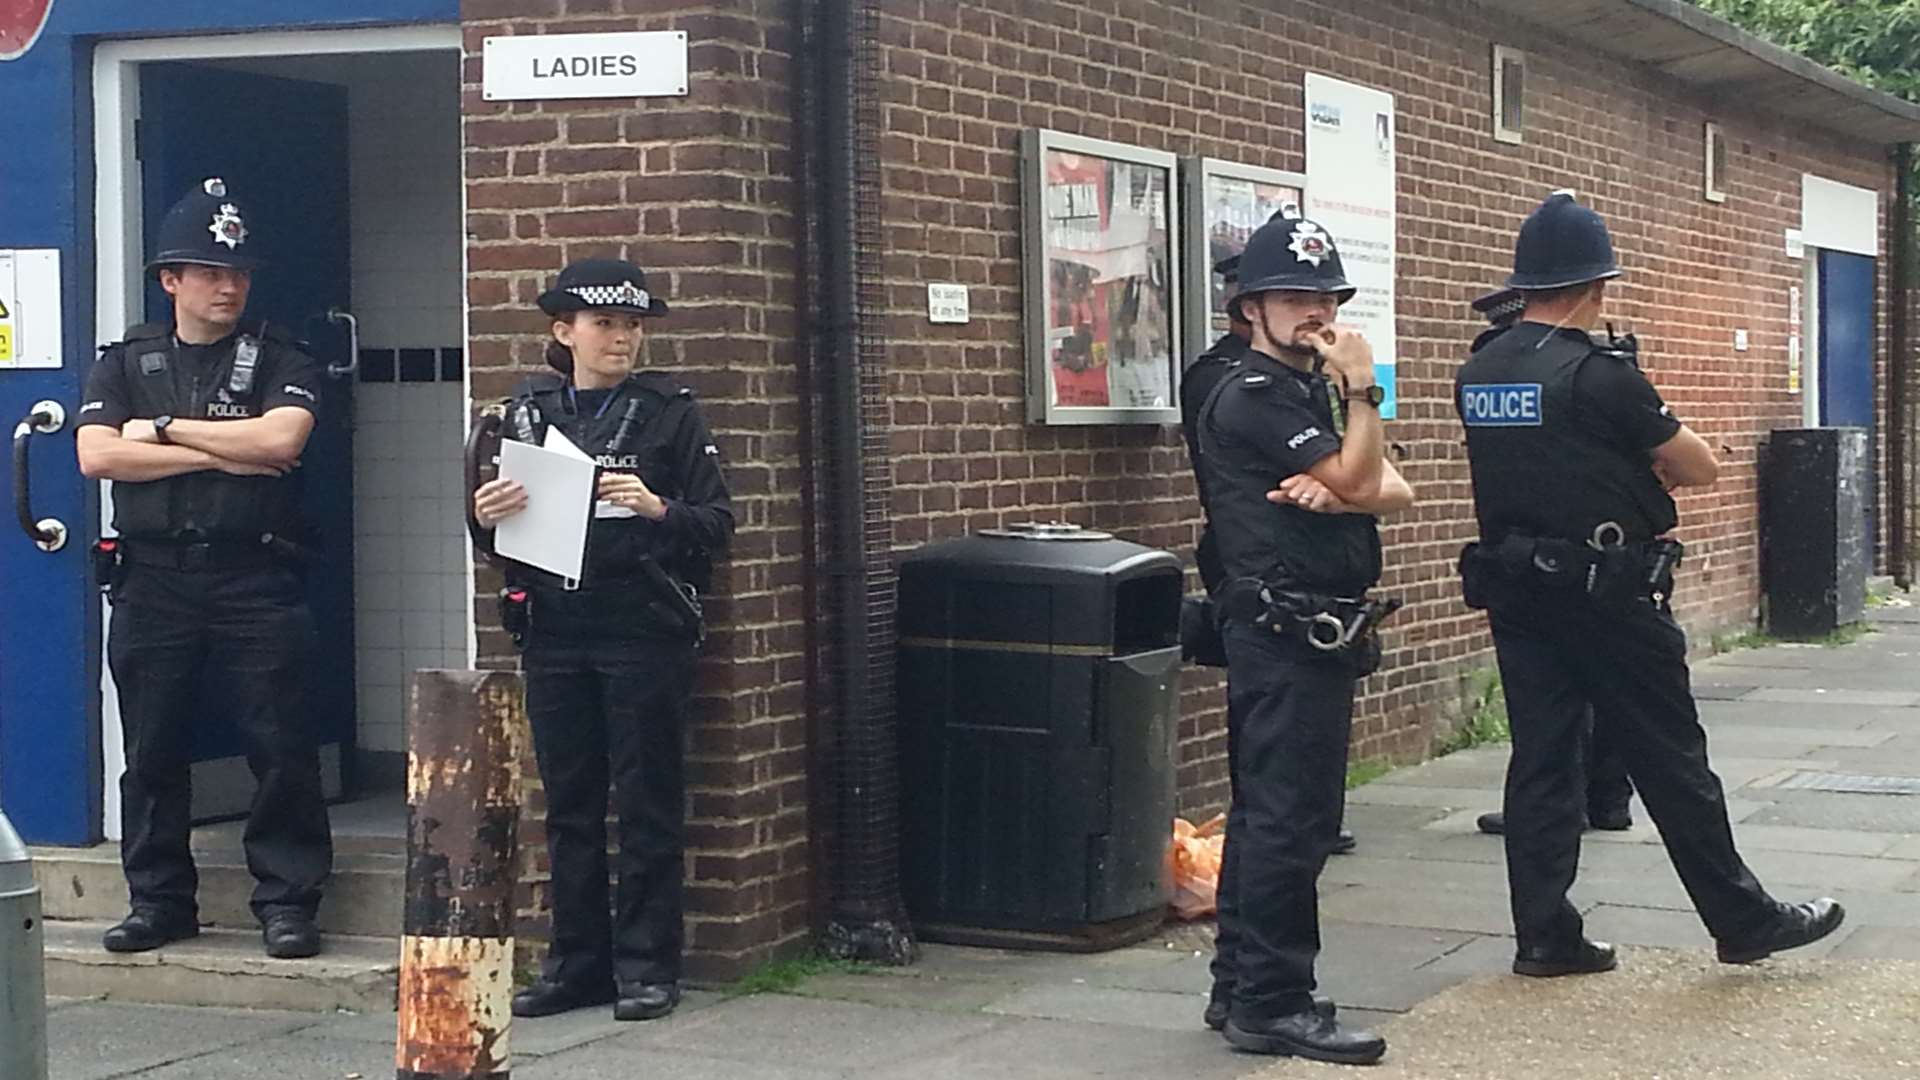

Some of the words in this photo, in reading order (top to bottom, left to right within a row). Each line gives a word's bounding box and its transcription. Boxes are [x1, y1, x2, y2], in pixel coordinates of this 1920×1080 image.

[532, 55, 637, 78] LADIES
[207, 403, 249, 417] POLICE
[1465, 391, 1536, 418] POLICE
[595, 454, 638, 468] POLICE
